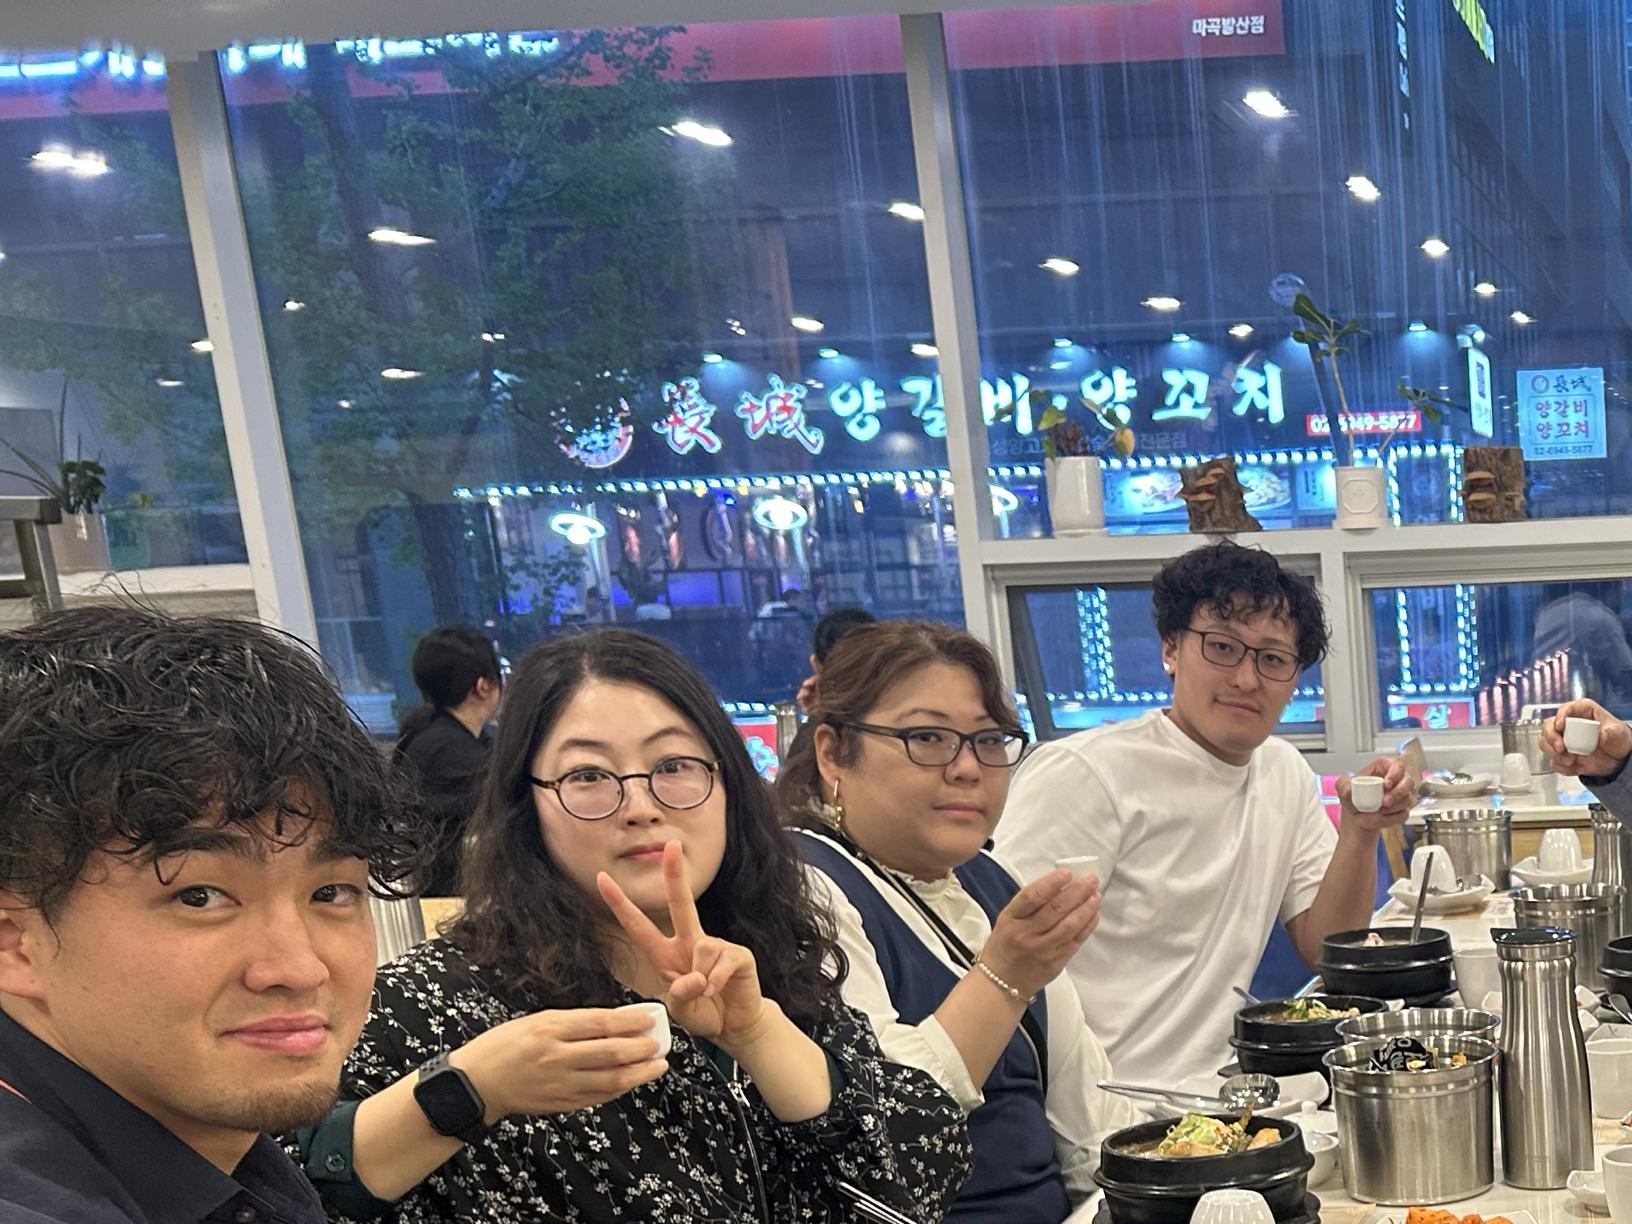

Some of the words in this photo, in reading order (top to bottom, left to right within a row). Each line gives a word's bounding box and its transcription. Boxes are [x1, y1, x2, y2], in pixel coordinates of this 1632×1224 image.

[1192, 16, 1265, 37] 마곡발산점
[1535, 399, 1589, 419] 양갈비
[1536, 420, 1590, 440] 양꼬치
